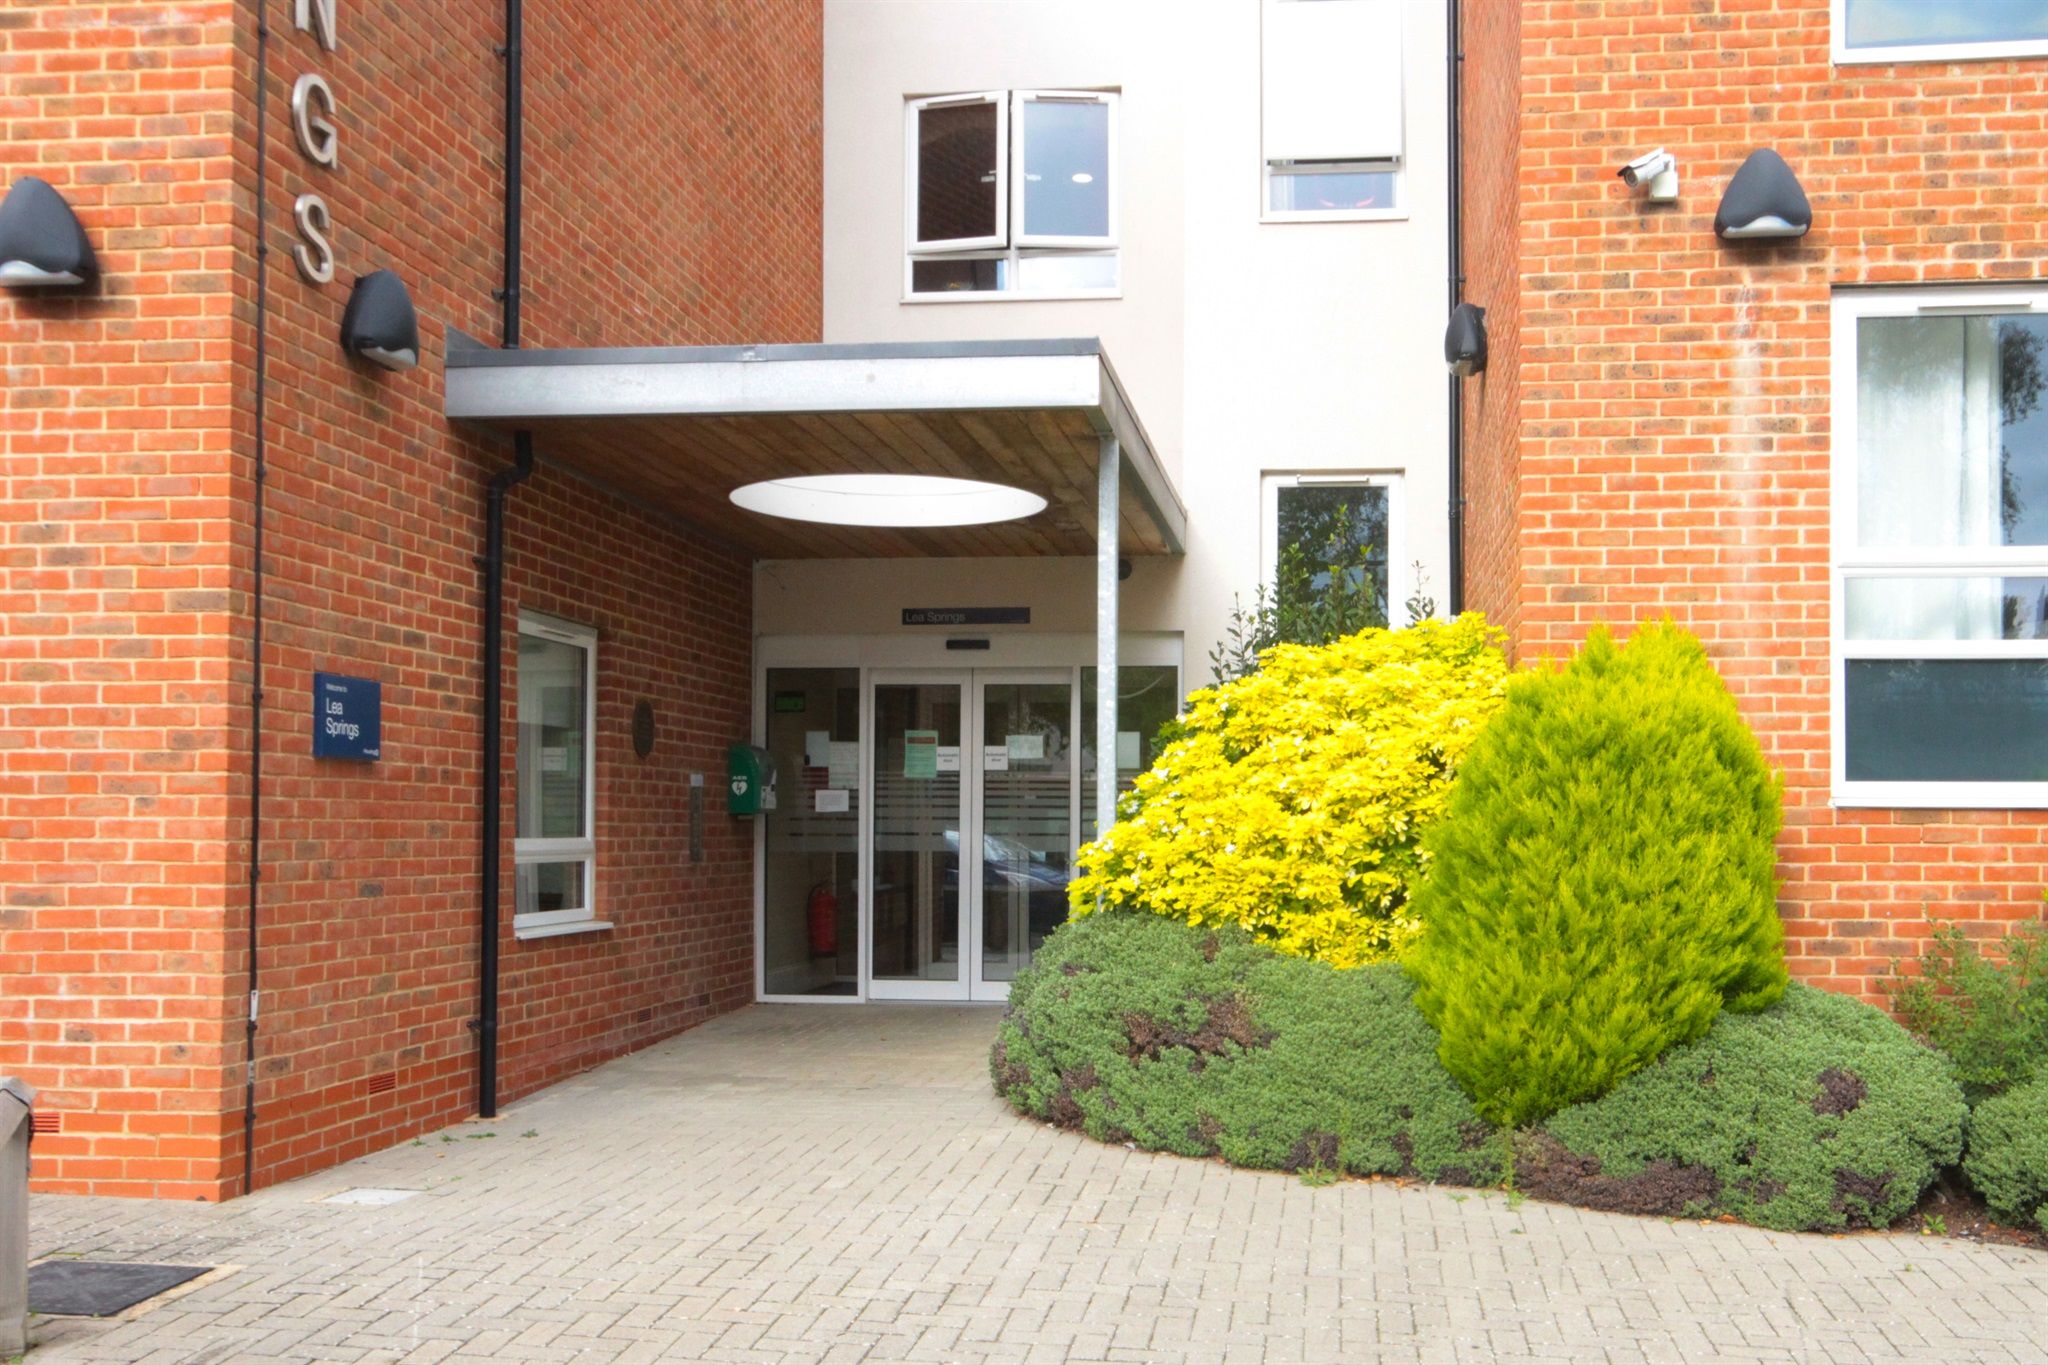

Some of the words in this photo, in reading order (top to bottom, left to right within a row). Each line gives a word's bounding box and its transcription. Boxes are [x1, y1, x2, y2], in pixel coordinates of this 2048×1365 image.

[905, 612, 924, 622] Lea
[927, 611, 966, 624] Springs
[326, 697, 343, 715] Lea
[325, 717, 360, 740] Springs
